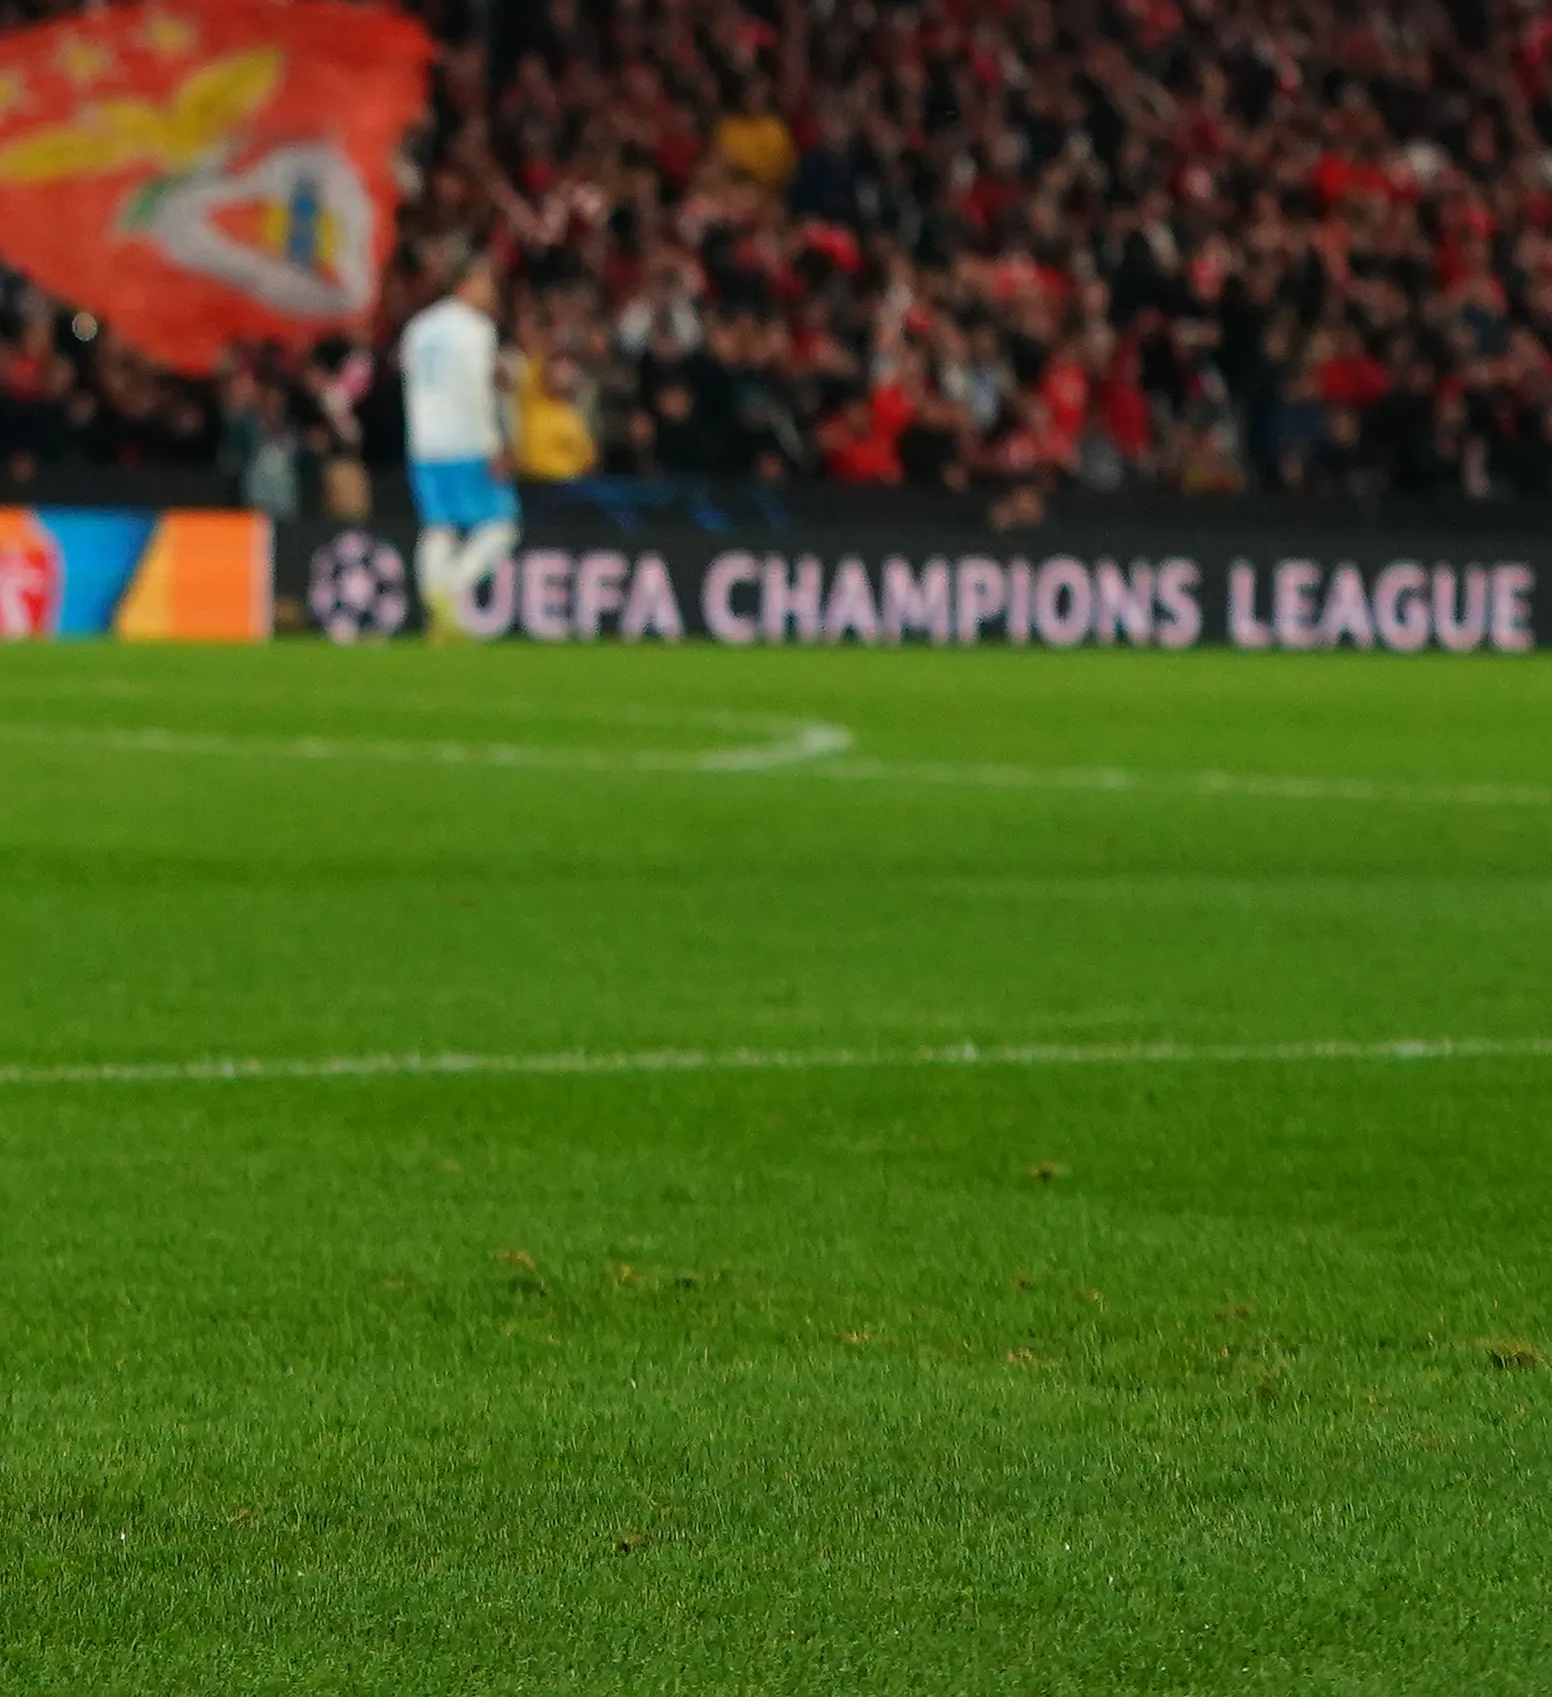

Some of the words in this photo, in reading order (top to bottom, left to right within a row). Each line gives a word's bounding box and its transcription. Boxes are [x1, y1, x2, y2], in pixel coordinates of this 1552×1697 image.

[458, 547, 686, 645] UEFA
[702, 549, 1203, 648] CHAMPIONS
[1227, 556, 1537, 654] LEAGUE
